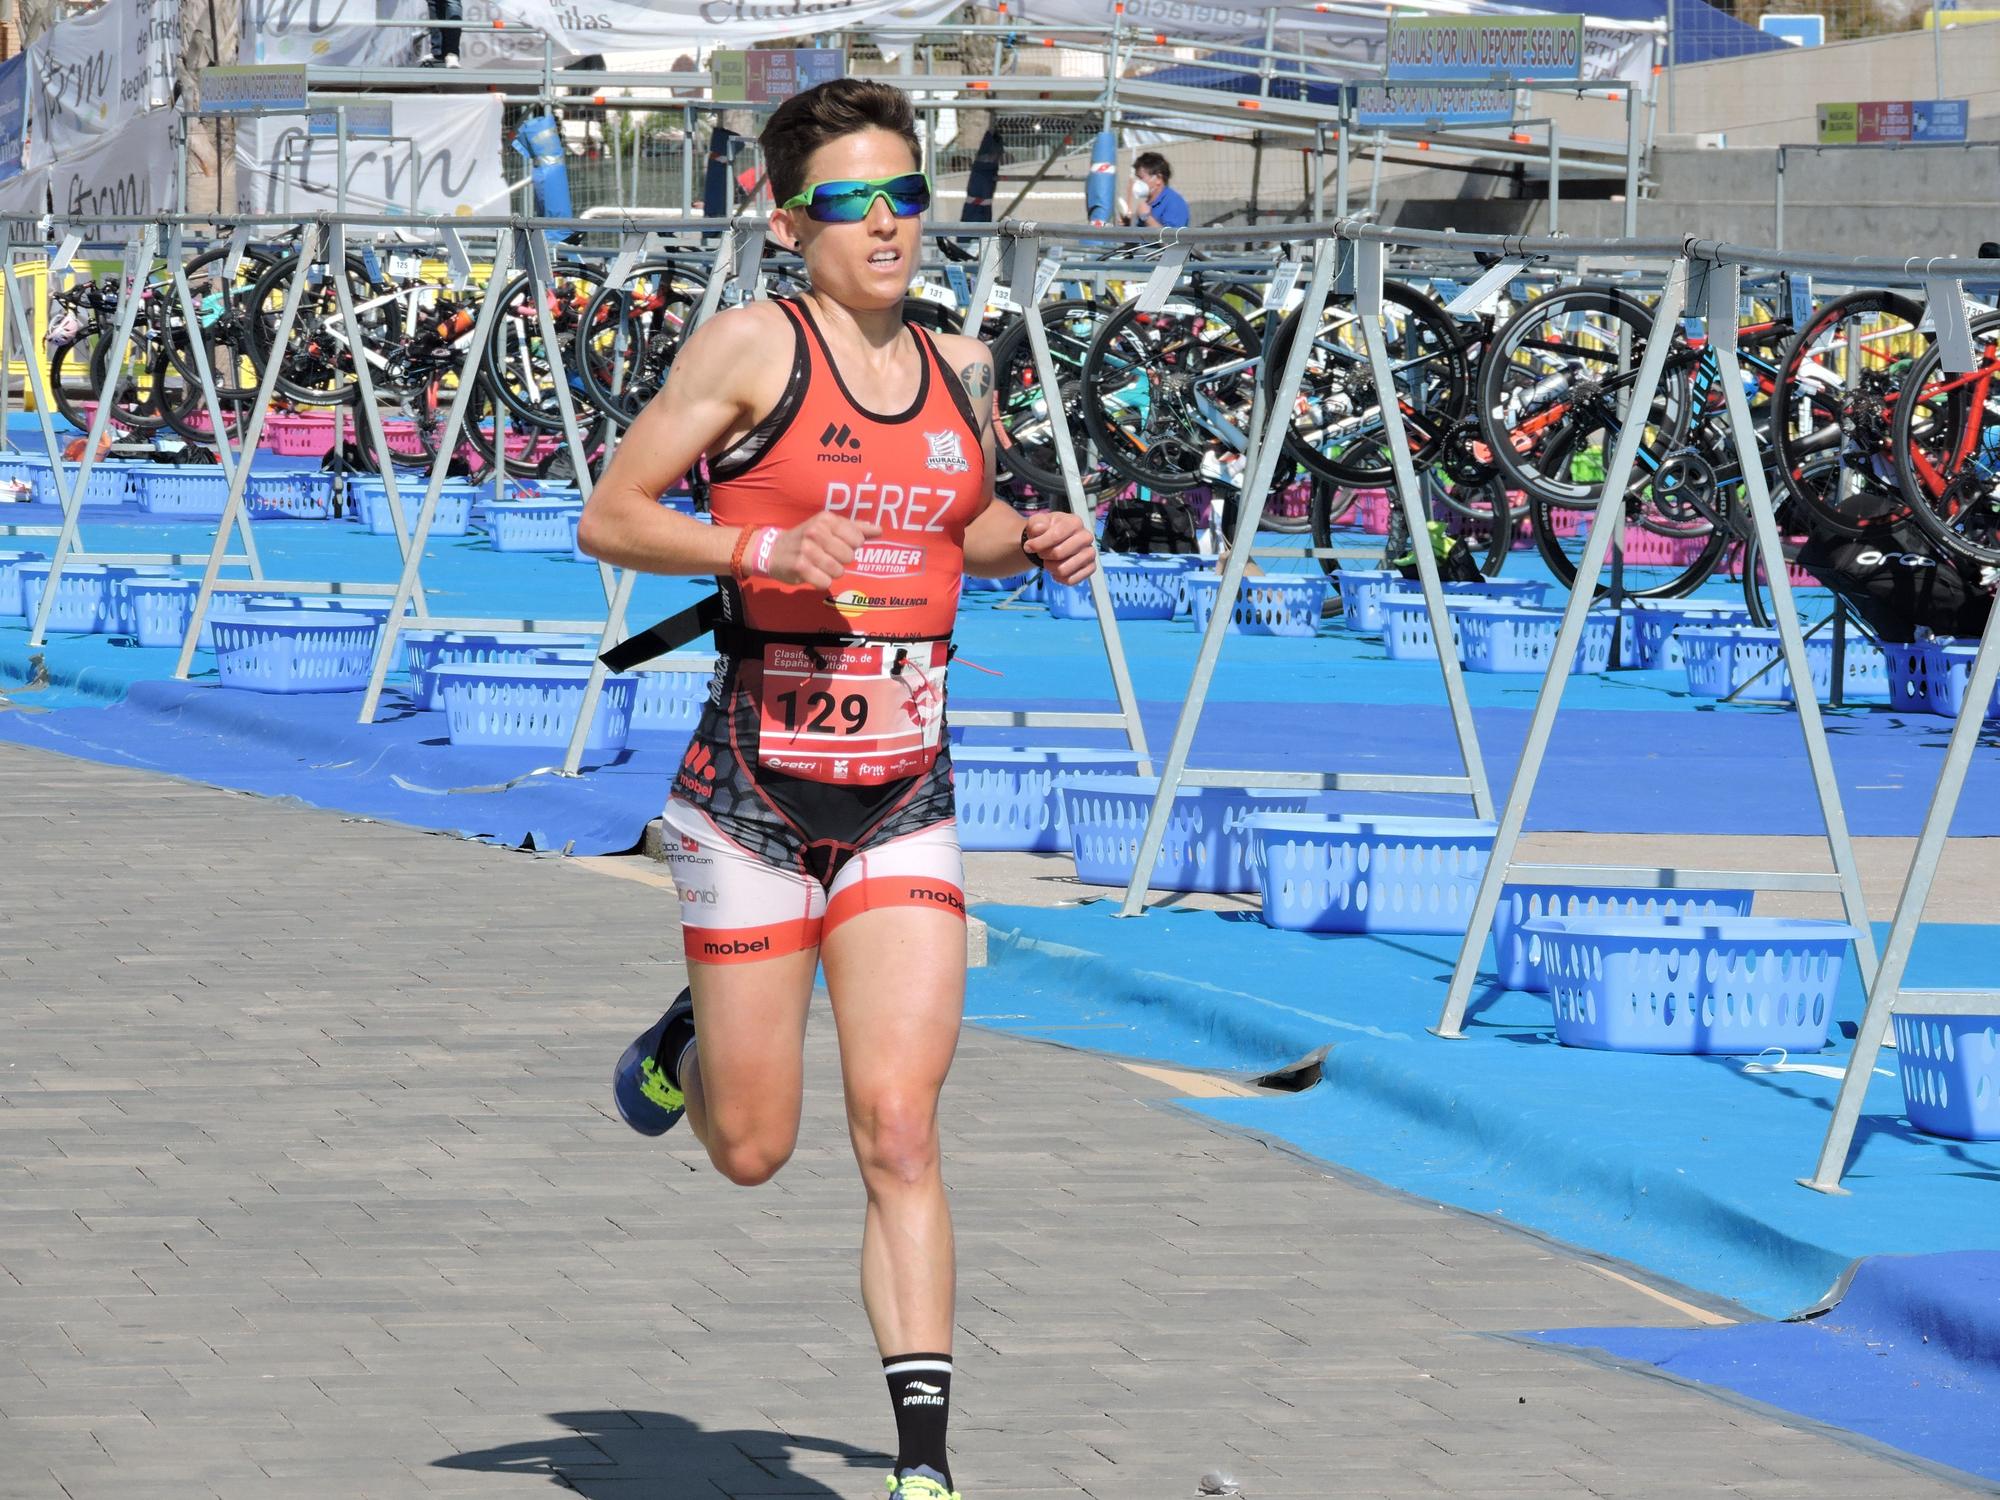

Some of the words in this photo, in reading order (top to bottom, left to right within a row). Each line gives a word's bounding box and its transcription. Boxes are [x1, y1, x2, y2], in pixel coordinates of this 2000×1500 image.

[1436, 28, 1458, 65] POR
[1460, 28, 1478, 65] UN
[1480, 28, 1527, 65] DEPORTE
[1530, 29, 1577, 66] SEGURO
[928, 287, 944, 299] 131
[994, 289, 1009, 300] 132
[816, 453, 862, 464] mobel
[928, 457, 966, 466] HURACÁN
[824, 471, 957, 533] PÉREZ
[853, 547, 922, 566] AMMER
[1856, 551, 1937, 567] orca
[856, 563, 907, 574] NUTRITION
[839, 653, 858, 663] Cto.
[860, 653, 873, 664] de
[776, 691, 869, 735] 129
[680, 773, 714, 798] mobel
[909, 887, 966, 915] mobe
[703, 936, 770, 955] mobel
[903, 1395, 945, 1407] SPORTLAST
